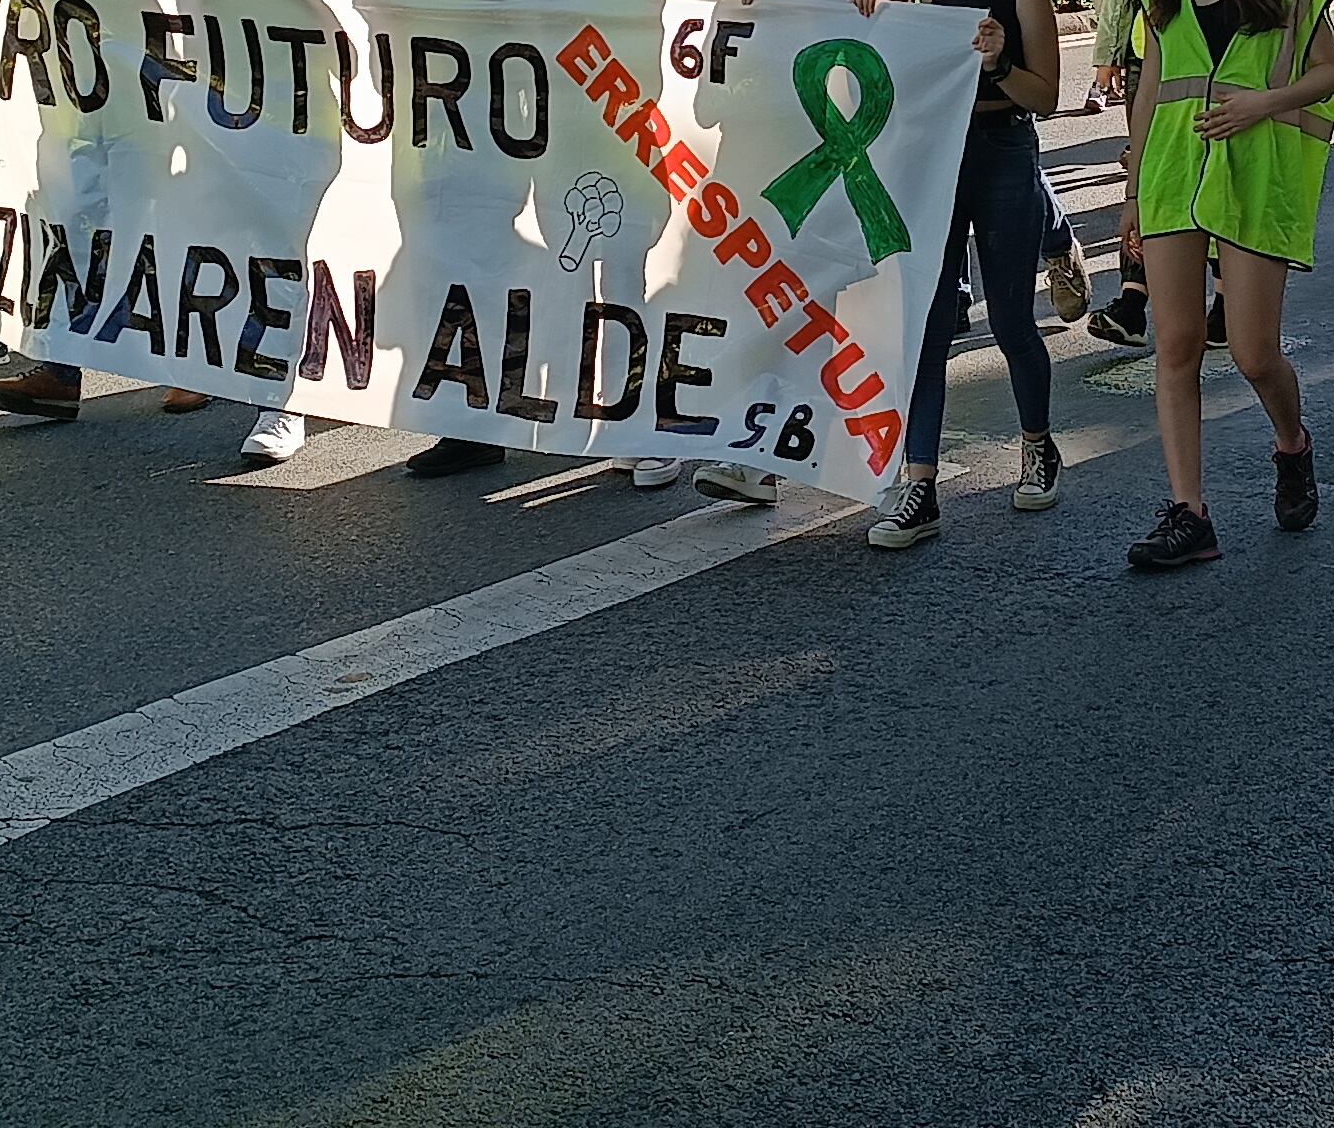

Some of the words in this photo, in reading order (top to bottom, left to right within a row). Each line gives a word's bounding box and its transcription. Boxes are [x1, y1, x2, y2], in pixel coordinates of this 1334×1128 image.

[139, 11, 549, 160] FUTURO
[670, 19, 755, 84] 6F
[555, 24, 905, 477] ERRESPETUA
[412, 284, 728, 436] ALDE
